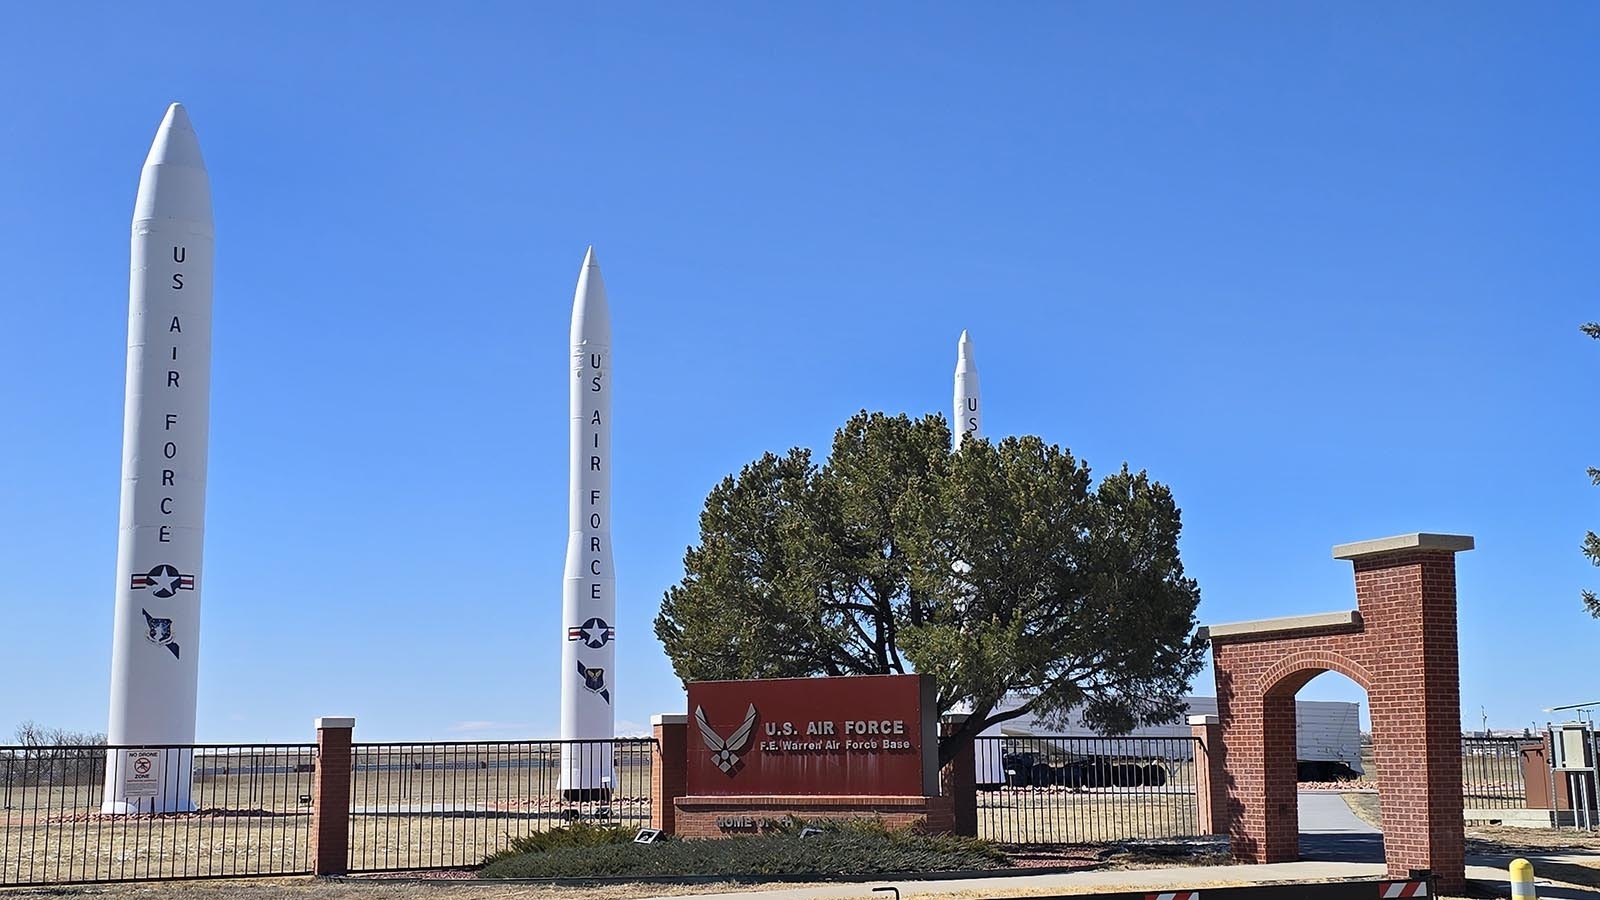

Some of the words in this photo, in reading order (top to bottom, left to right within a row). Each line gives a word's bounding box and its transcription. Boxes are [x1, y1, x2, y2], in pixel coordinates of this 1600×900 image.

[172, 246, 186, 290] US
[167, 316, 181, 388] AIR
[591, 353, 601, 392] US
[968, 397, 978, 431] US
[590, 409, 601, 471] AIR
[159, 414, 177, 543] FORCE
[590, 490, 601, 599] FORCE
[760, 741, 779, 751] F.E.
[782, 740, 822, 751] Warren
[825, 740, 841, 750] Air
[845, 739, 878, 750] Force
[882, 739, 910, 749] Base
[765, 721, 798, 736] U.S.
[806, 721, 835, 735] AIR
[845, 720, 904, 735] FORCE
[716, 815, 753, 828] HOME
